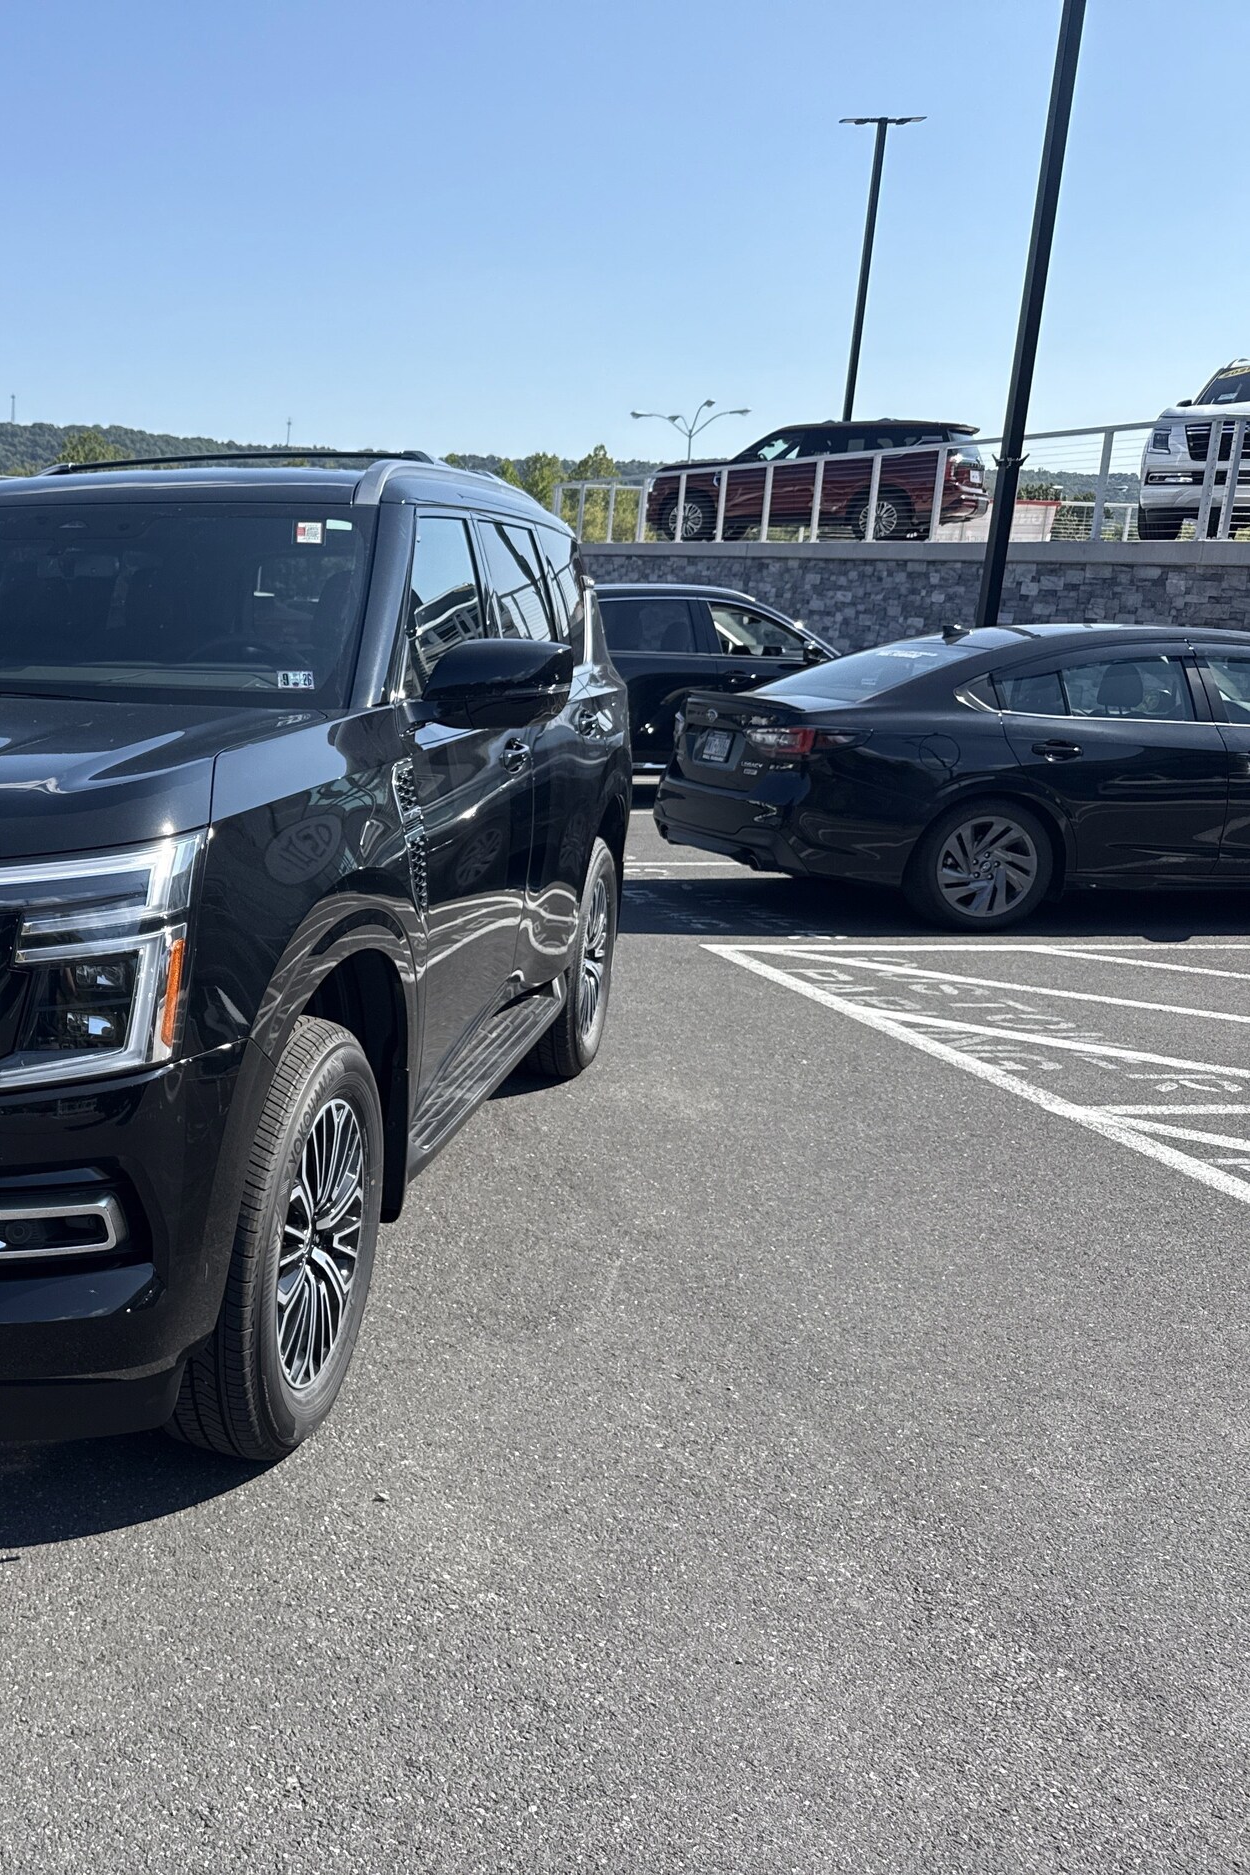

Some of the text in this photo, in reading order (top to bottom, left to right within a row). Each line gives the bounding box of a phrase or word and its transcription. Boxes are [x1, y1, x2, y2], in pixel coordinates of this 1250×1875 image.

[282, 673, 312, 686] 9 26
[778, 968, 1064, 1071] PARING
[288, 1067, 334, 1166] YOKOHAMA
